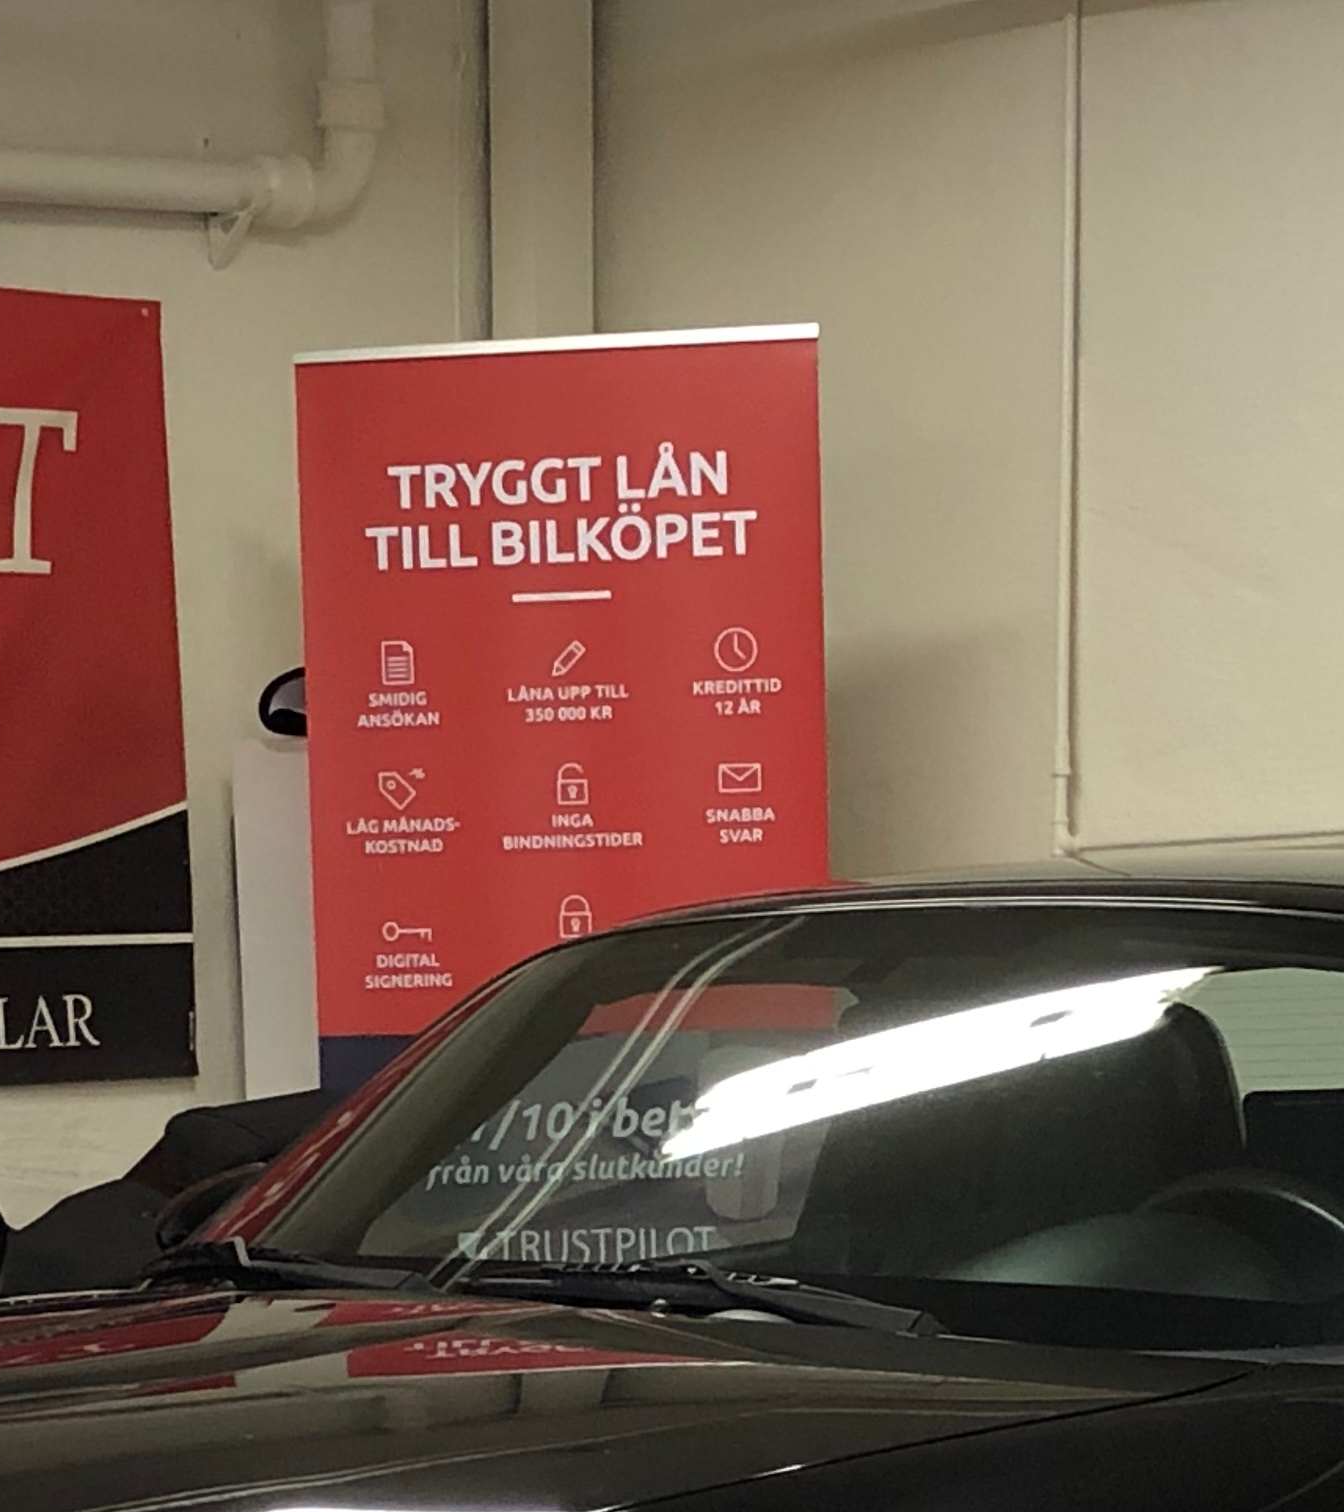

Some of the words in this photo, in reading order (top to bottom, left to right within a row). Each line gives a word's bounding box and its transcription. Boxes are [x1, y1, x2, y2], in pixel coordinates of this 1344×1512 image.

[387, 456, 602, 510] TRYGGT
[616, 441, 729, 500] LÅN
[365, 524, 478, 571] TILL
[491, 502, 758, 567] BILKÖPET
[507, 685, 554, 702] LÅNA
[558, 685, 591, 700] UPP
[596, 684, 630, 699] TILL
[693, 678, 782, 696] KREDITTID
[368, 691, 428, 708] SMIDIG
[715, 701, 734, 715] 12
[738, 697, 761, 714] ÅR
[357, 709, 441, 729] ANSÖKAN
[525, 707, 554, 722] 350
[558, 706, 586, 721] 000
[590, 705, 612, 720] KR
[552, 813, 594, 828] INGA
[706, 807, 776, 823] SNABBA
[346, 818, 379, 835] LÅG
[383, 815, 461, 833] MÅNADS-
[503, 832, 643, 850] BINDNINGSTIDER
[720, 828, 763, 843] SVAR
[365, 838, 444, 855] KOSTNAD
[376, 952, 440, 968] DIGITAL
[365, 973, 453, 989] SIGNERING
[470, 1099, 576, 1151] /10
